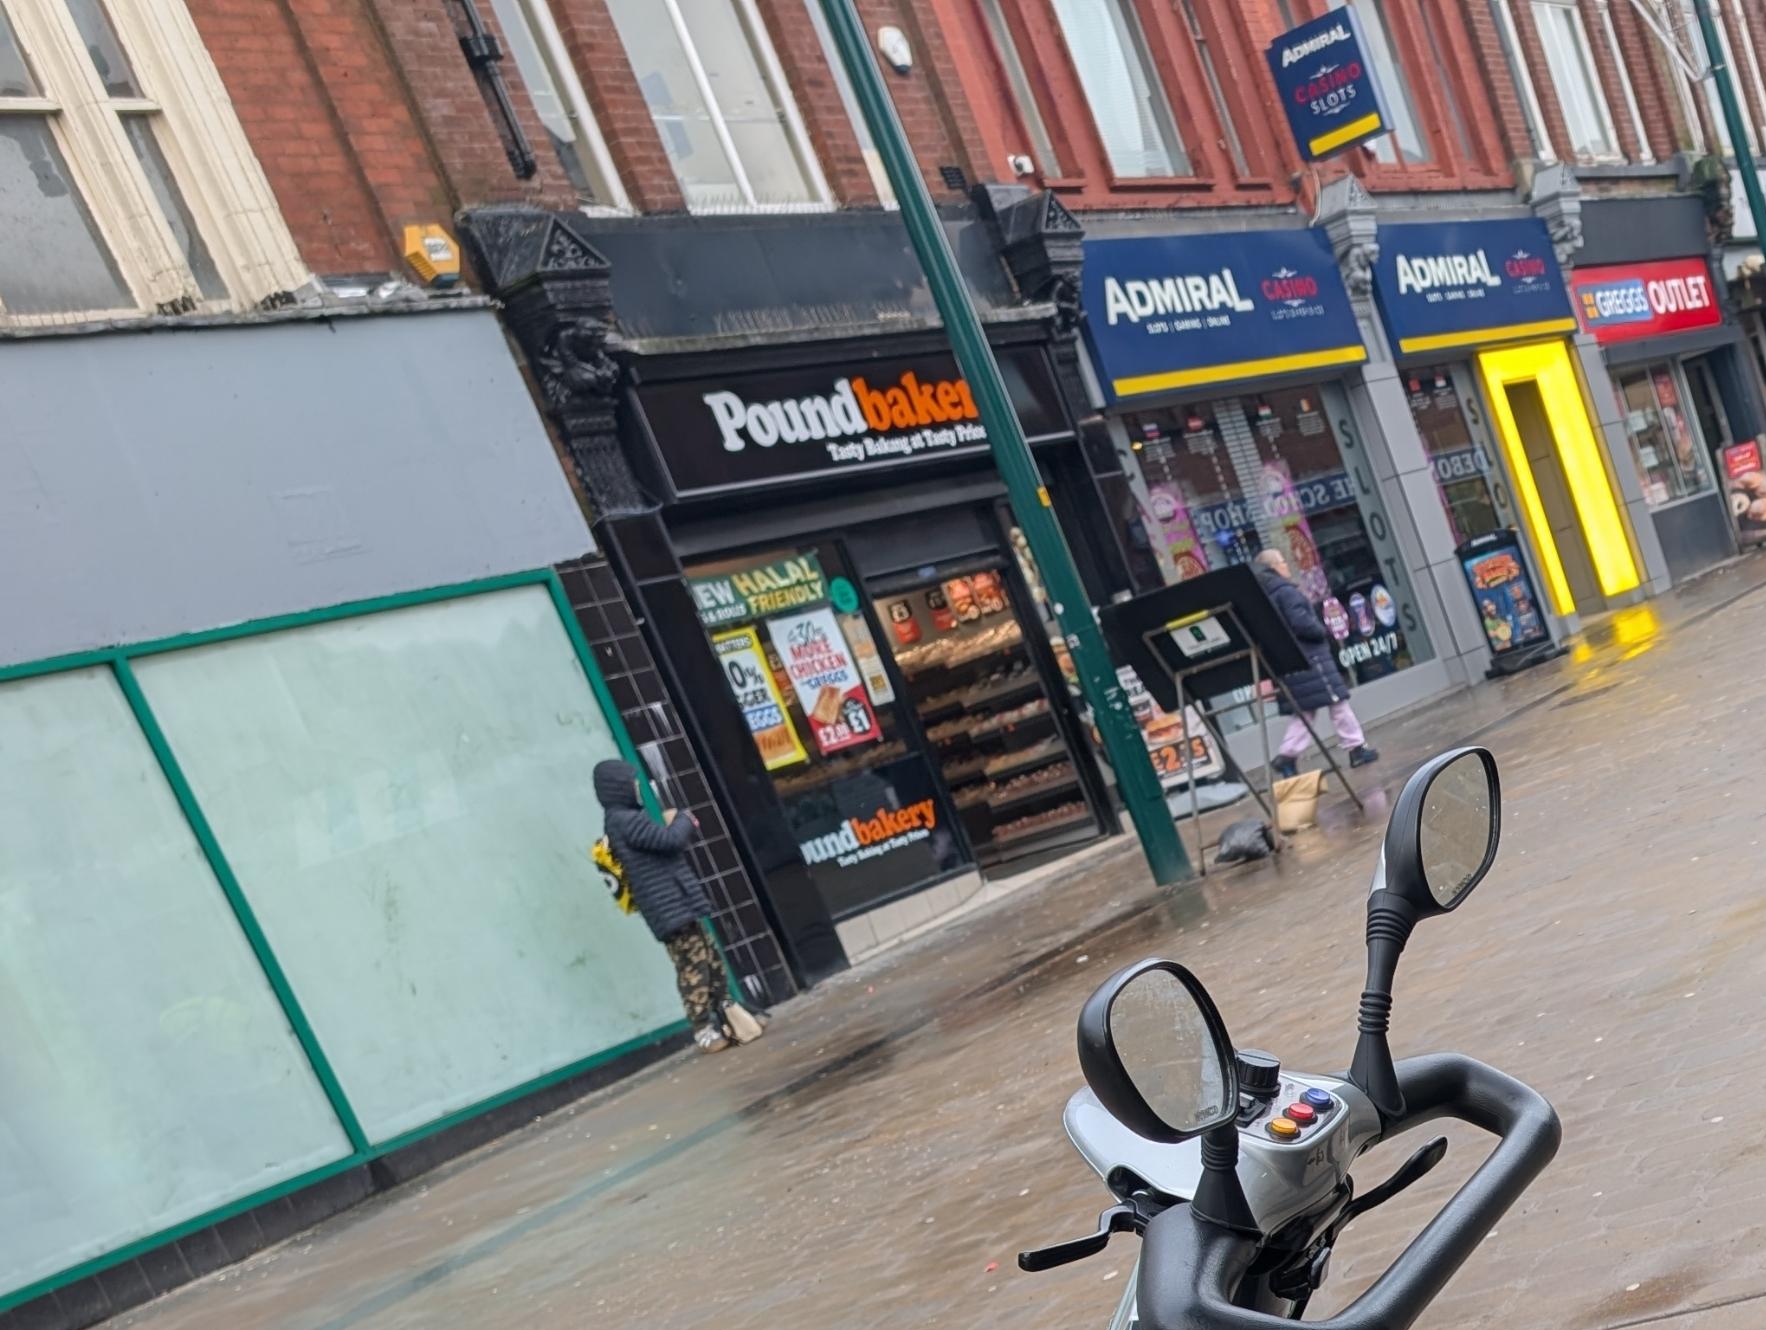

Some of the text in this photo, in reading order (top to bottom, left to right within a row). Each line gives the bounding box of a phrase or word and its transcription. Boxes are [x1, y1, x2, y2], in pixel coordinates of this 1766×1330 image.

[1282, 24, 1351, 68] ADMIRAL
[1295, 62, 1361, 104] CASINO
[1310, 85, 1356, 115] SLOTS
[1261, 276, 1318, 300] CASINO
[1396, 249, 1502, 294] ADMIRAL
[1104, 267, 1254, 325] ADMIRAL
[1595, 275, 1711, 318] GREGGS OUTLET
[703, 370, 980, 452] Poundbaker
[826, 424, 987, 462] Tasty Baking at Tasty Price
[731, 557, 819, 597] HALAL
[747, 581, 824, 616] FRIENDLY
[1339, 632, 1397, 667] OPEN 24/7
[800, 799, 936, 866] undbakery
